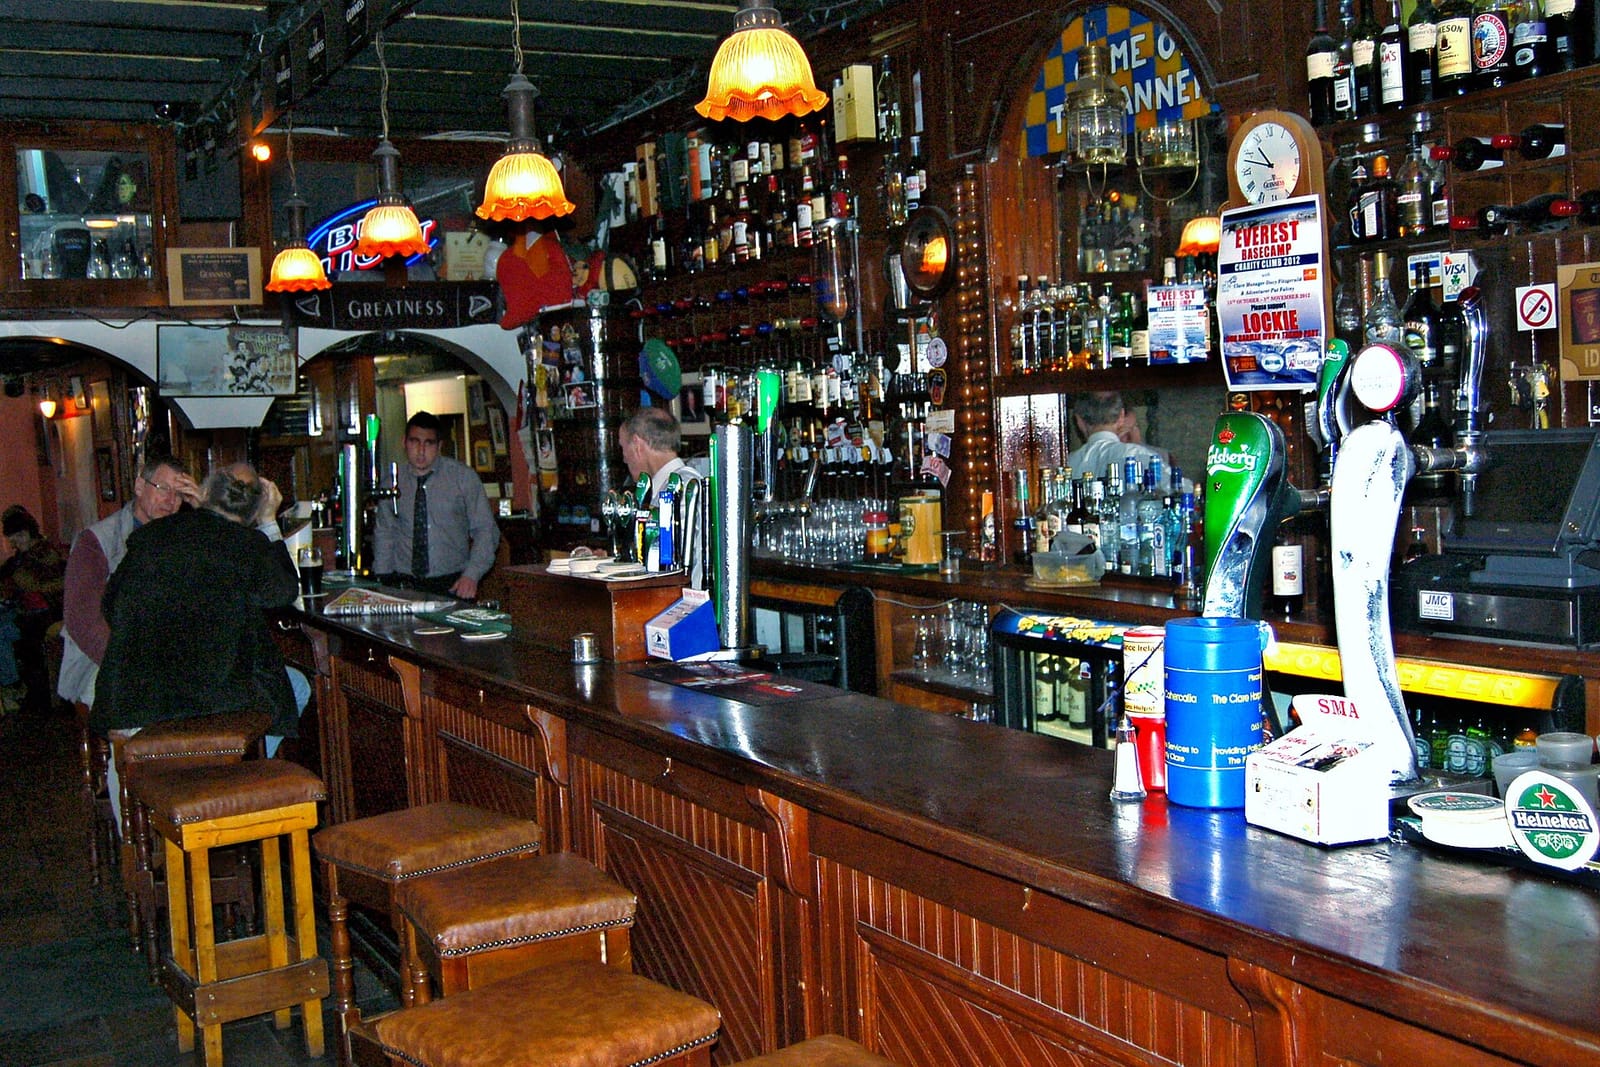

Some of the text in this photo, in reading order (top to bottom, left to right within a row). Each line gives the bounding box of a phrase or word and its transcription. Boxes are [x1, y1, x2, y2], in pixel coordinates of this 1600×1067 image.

[1235, 220, 1300, 248] EVEREST
[1241, 243, 1292, 260] BASECAMP
[1234, 255, 1301, 272] CHARITY CLIMB 2012
[1444, 263, 1466, 275] VISA
[348, 300, 445, 319] GREATNESS
[1250, 302, 1286, 311] Please support
[1242, 310, 1299, 334] LOCKIE
[1425, 594, 1448, 606] JMC
[1211, 694, 1228, 704] The
[1228, 691, 1249, 703] Clare
[1317, 698, 1360, 719] SMA
[1191, 746, 1200, 754] to
[1214, 744, 1247, 756] Providing
[1170, 752, 1186, 763] Clare
[1227, 756, 1242, 765] The
[1515, 812, 1590, 831] Heineken
